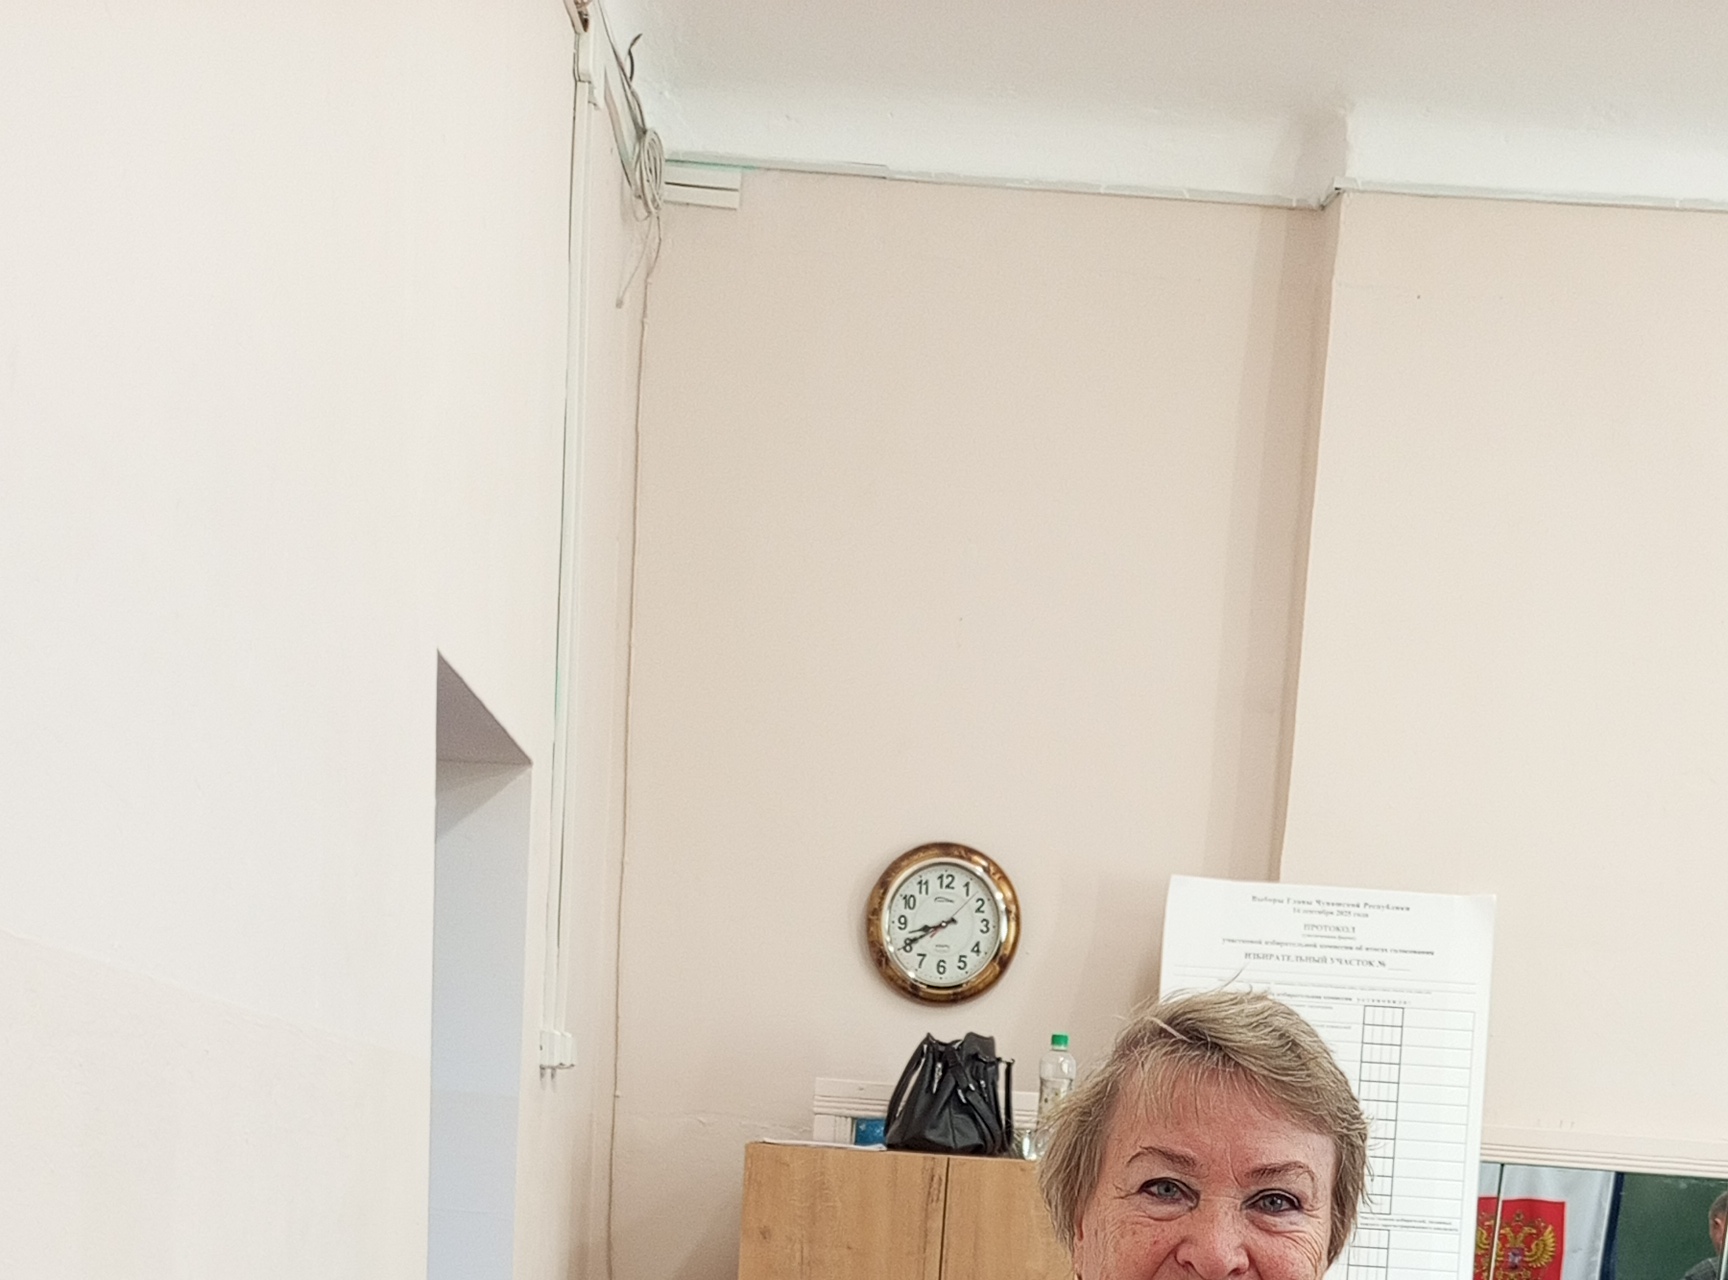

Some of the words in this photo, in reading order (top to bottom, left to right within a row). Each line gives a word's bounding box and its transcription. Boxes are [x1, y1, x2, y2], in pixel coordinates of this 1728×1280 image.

[917, 879, 929, 895] 11
[937, 874, 955, 890] 12
[963, 881, 970, 897] 1
[903, 894, 916, 910] 10
[975, 898, 985, 913] 2
[898, 915, 907, 930] 9
[980, 918, 990, 934] 3
[903, 938, 913, 953] 8
[971, 941, 981, 956] 4
[916, 953, 926, 968] 7
[936, 959, 946, 975] 6
[957, 955, 967, 970] 5
